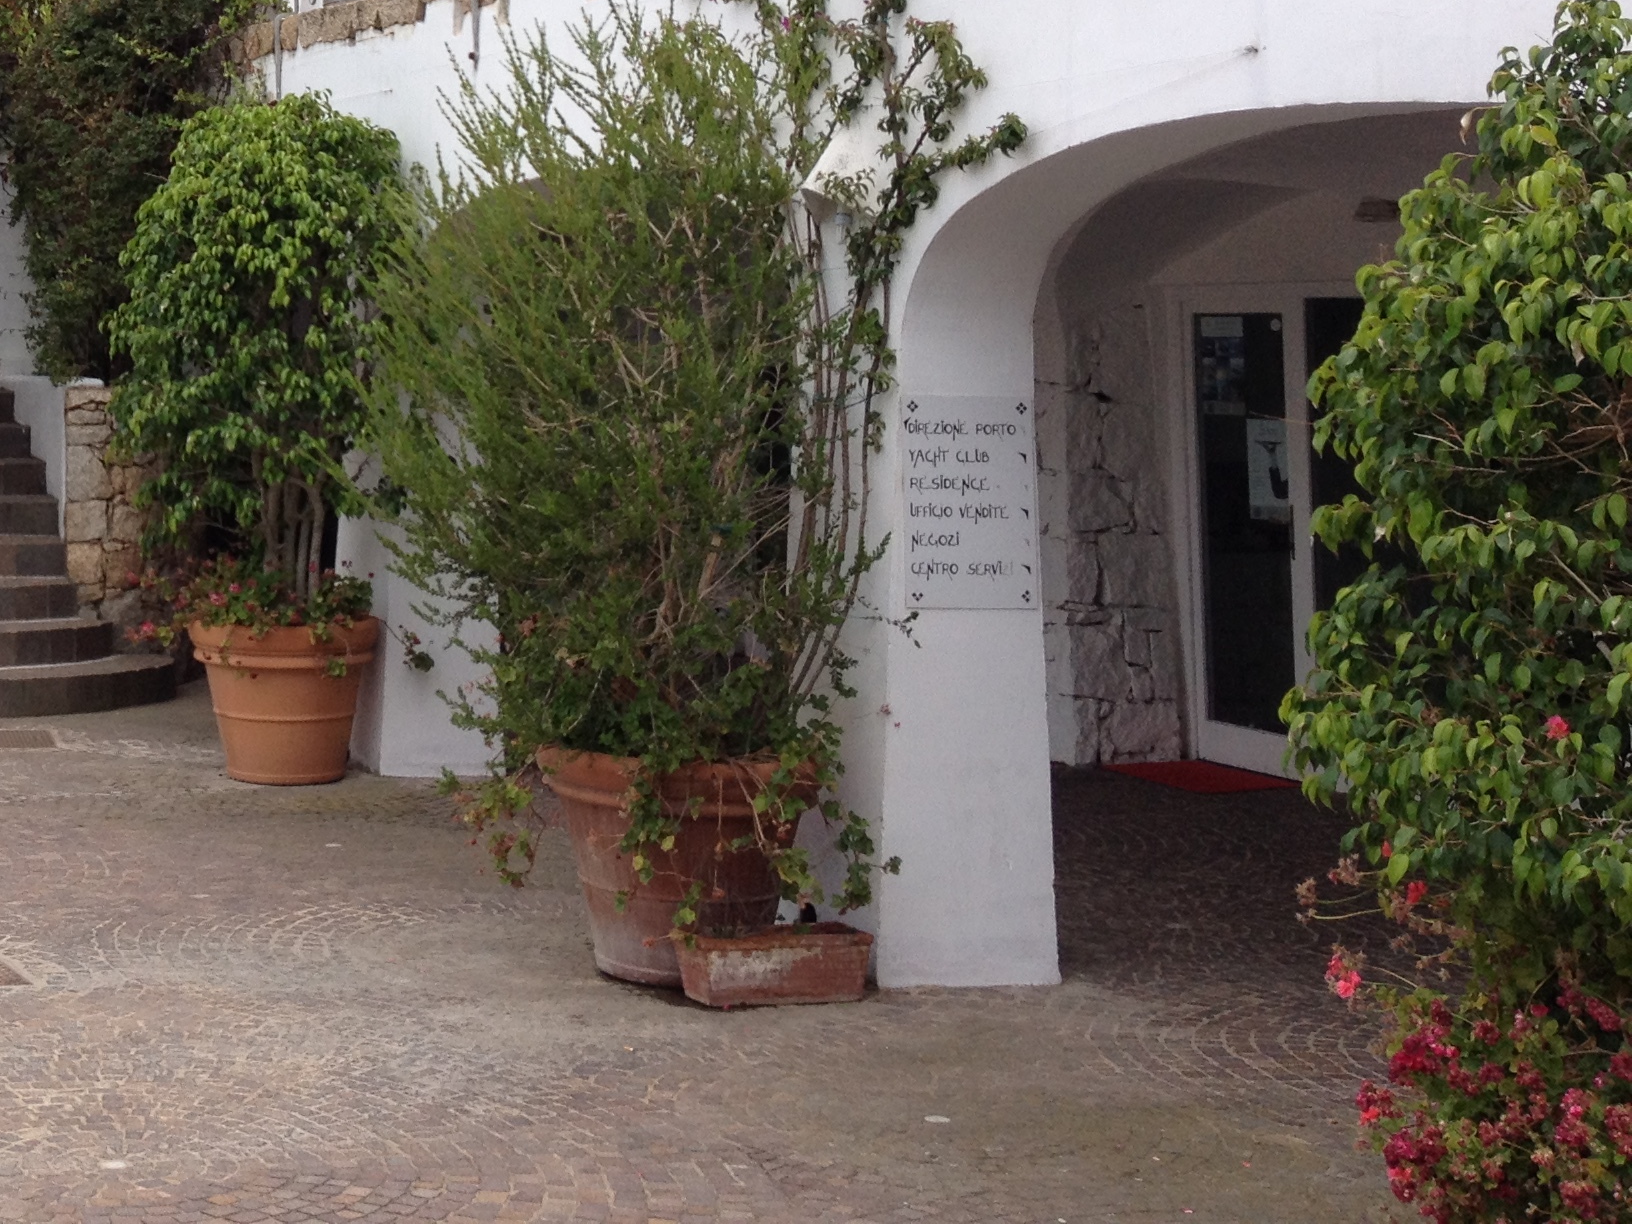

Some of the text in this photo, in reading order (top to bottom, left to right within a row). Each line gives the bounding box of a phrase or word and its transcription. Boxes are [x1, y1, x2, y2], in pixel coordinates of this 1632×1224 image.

[975, 422, 1017, 442] PORTO
[908, 447, 990, 468] YACHT CLUB
[911, 559, 959, 581] CENTRO
